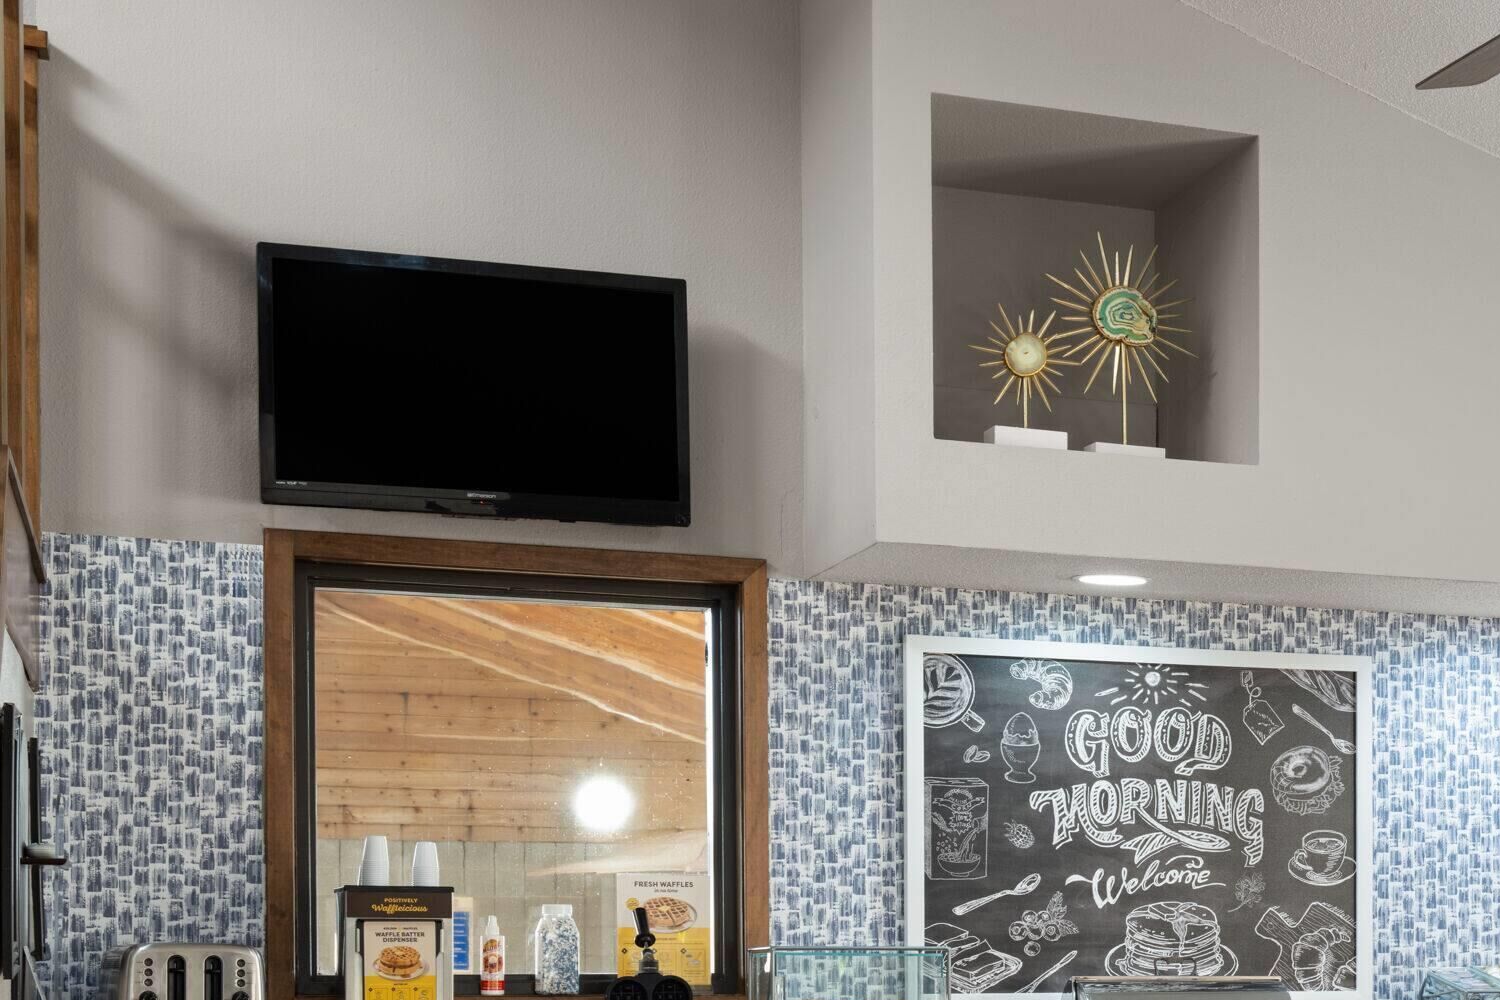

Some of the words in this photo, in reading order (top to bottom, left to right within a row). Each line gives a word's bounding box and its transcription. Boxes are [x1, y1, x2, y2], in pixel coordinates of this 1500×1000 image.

[1065, 706, 1232, 778] GOOD
[1029, 777, 1265, 868] MORNING
[1065, 855, 1226, 909] Welcome
